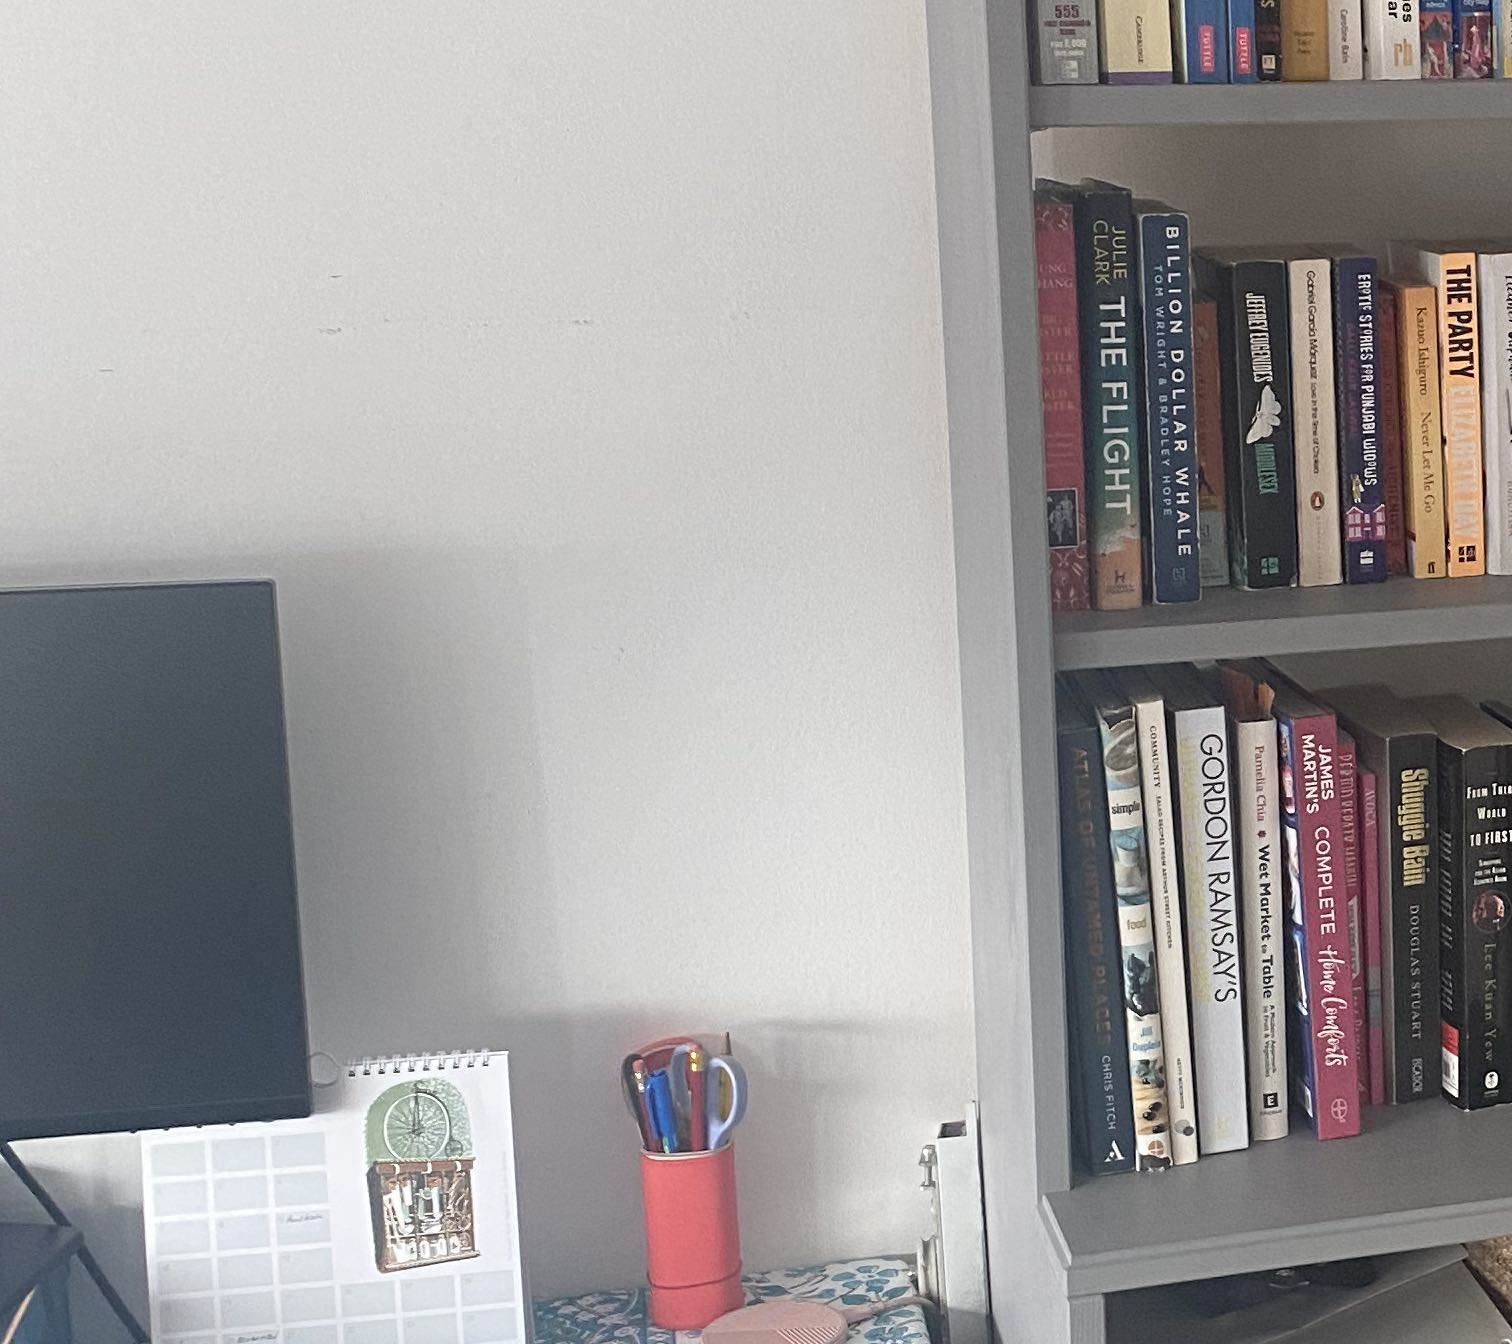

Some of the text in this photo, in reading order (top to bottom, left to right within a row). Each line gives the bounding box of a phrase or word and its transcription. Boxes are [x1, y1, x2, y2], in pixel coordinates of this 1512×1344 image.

[1055, 5, 1079, 18] 555
[1093, 219, 1109, 285] CLARK
[1112, 225, 1127, 279] JULIE
[1245, 293, 1272, 383] JEFFREY EUGENIDES
[1446, 265, 1475, 378] THE PARTY
[1099, 296, 1130, 515] THE FLIGHT
[1166, 227, 1191, 555] BILLION DOLLAR WHALE
[1361, 385, 1375, 434] PUNJABI
[1415, 306, 1435, 513] Kazuo Ishiguro Go
[1150, 725, 1161, 787] COMMUNITY
[1301, 734, 1319, 814] MARTIN'S
[1317, 744, 1333, 800] JAMES
[1111, 800, 1141, 816] simple
[1199, 734, 1237, 1003] GORDON RAMSAY'S
[1314, 827, 1336, 935] COMPLETE
[1397, 768, 1429, 1040] Shuggie Bain DOUGLAS STUART
[1127, 919, 1148, 932] food
[1258, 845, 1273, 999] Wet Market Table
[1101, 1055, 1118, 1129] CHRIS FITCH
